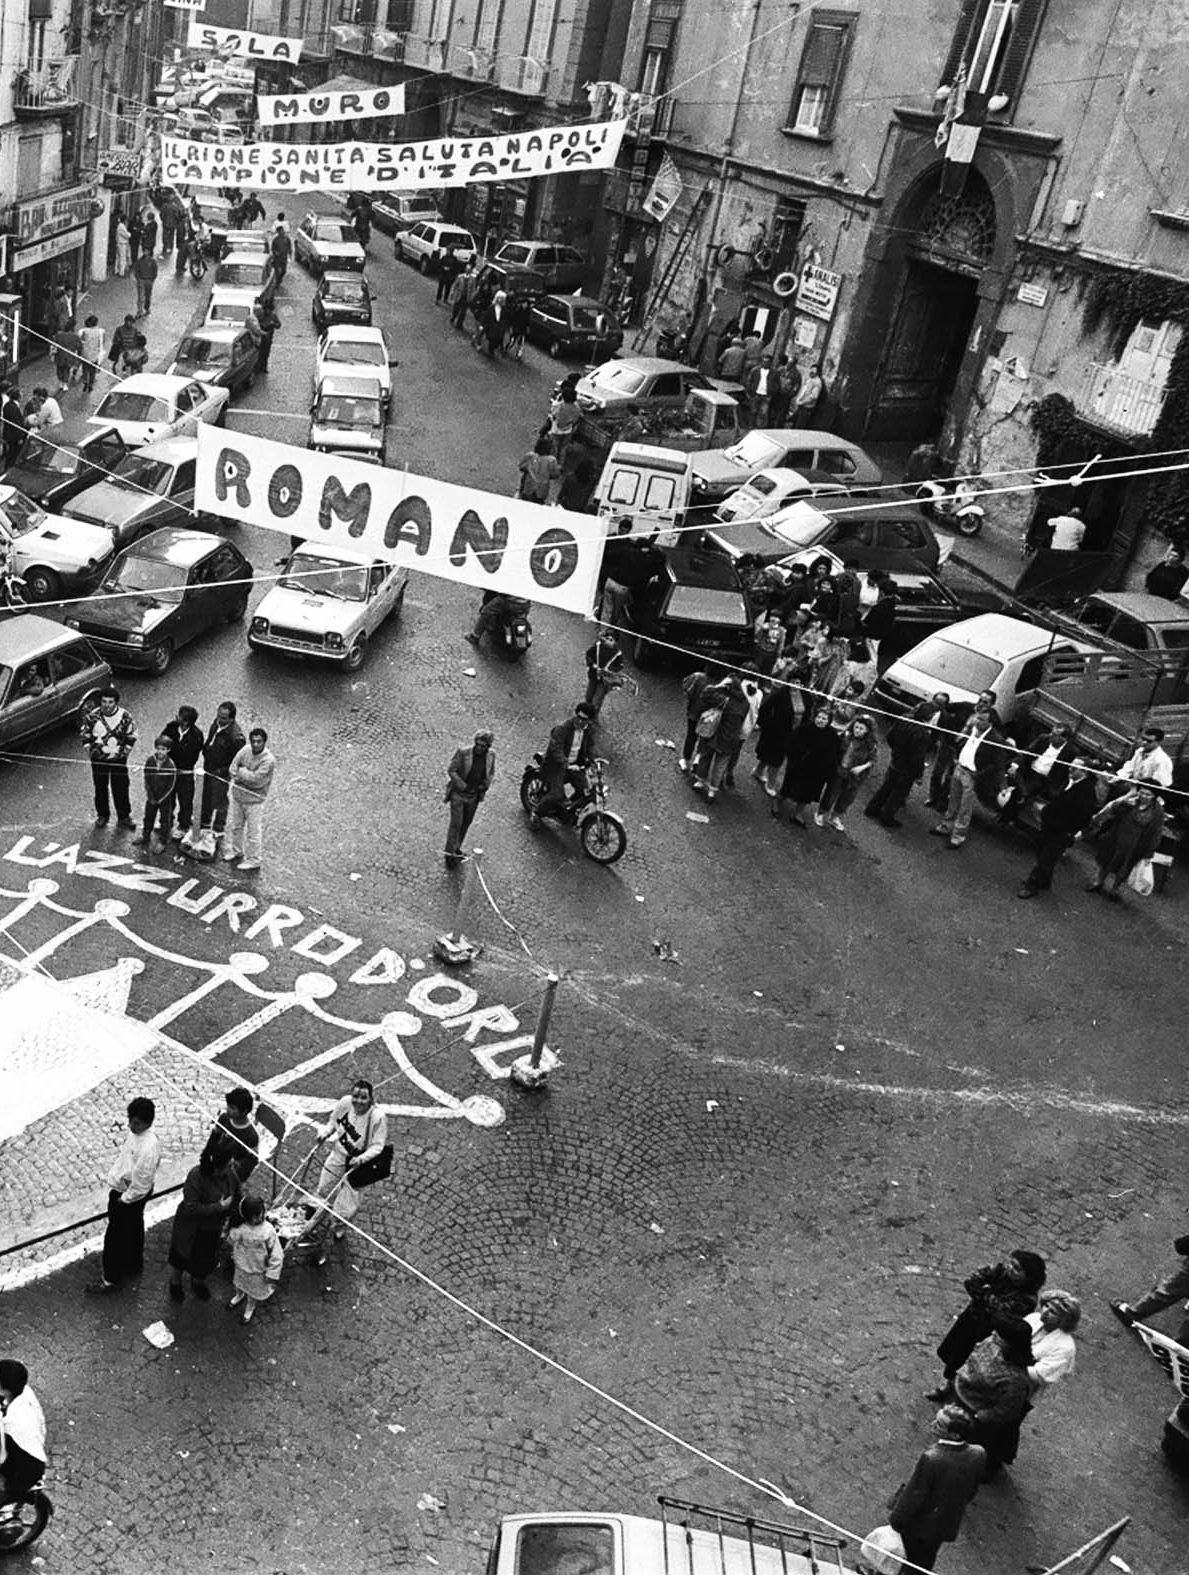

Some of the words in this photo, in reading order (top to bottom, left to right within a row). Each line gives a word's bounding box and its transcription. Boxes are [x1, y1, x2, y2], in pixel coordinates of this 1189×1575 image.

[200, 29, 291, 59] SOLA
[273, 90, 391, 118] MURO
[164, 142, 182, 160] IL
[187, 144, 261, 165] RIONE
[377, 141, 495, 163] SALUTA
[507, 128, 608, 154] NAPOLI
[166, 163, 347, 185] CAMPIONE
[215, 447, 579, 588] ROMANO
[2, 834, 363, 966] L'AZZURRO
